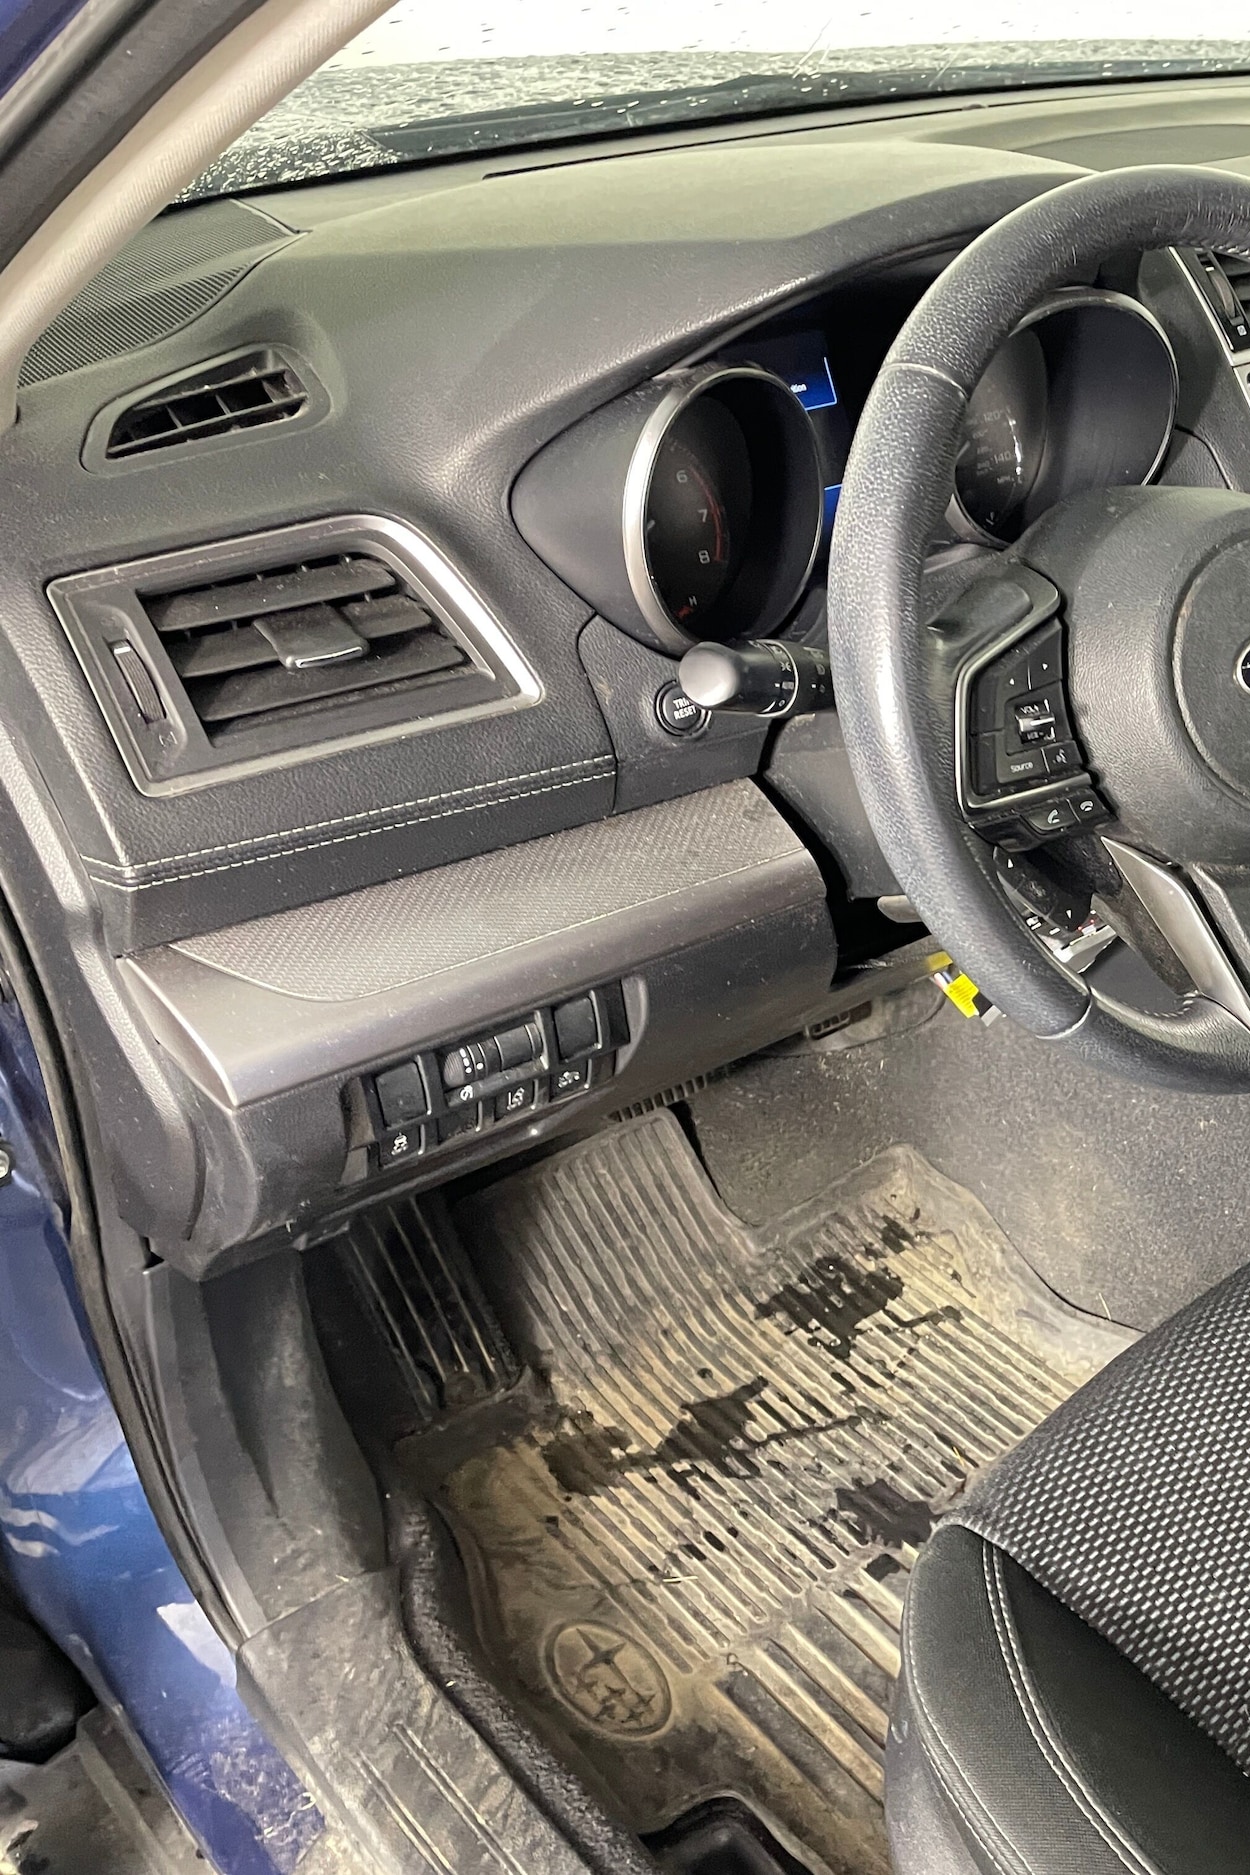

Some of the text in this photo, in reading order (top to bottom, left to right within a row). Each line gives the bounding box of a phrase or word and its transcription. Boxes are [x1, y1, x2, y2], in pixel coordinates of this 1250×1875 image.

[676, 470, 688, 483] 6
[697, 508, 708, 523] 7
[698, 549, 710, 564] 8
[673, 704, 697, 720] RESET
